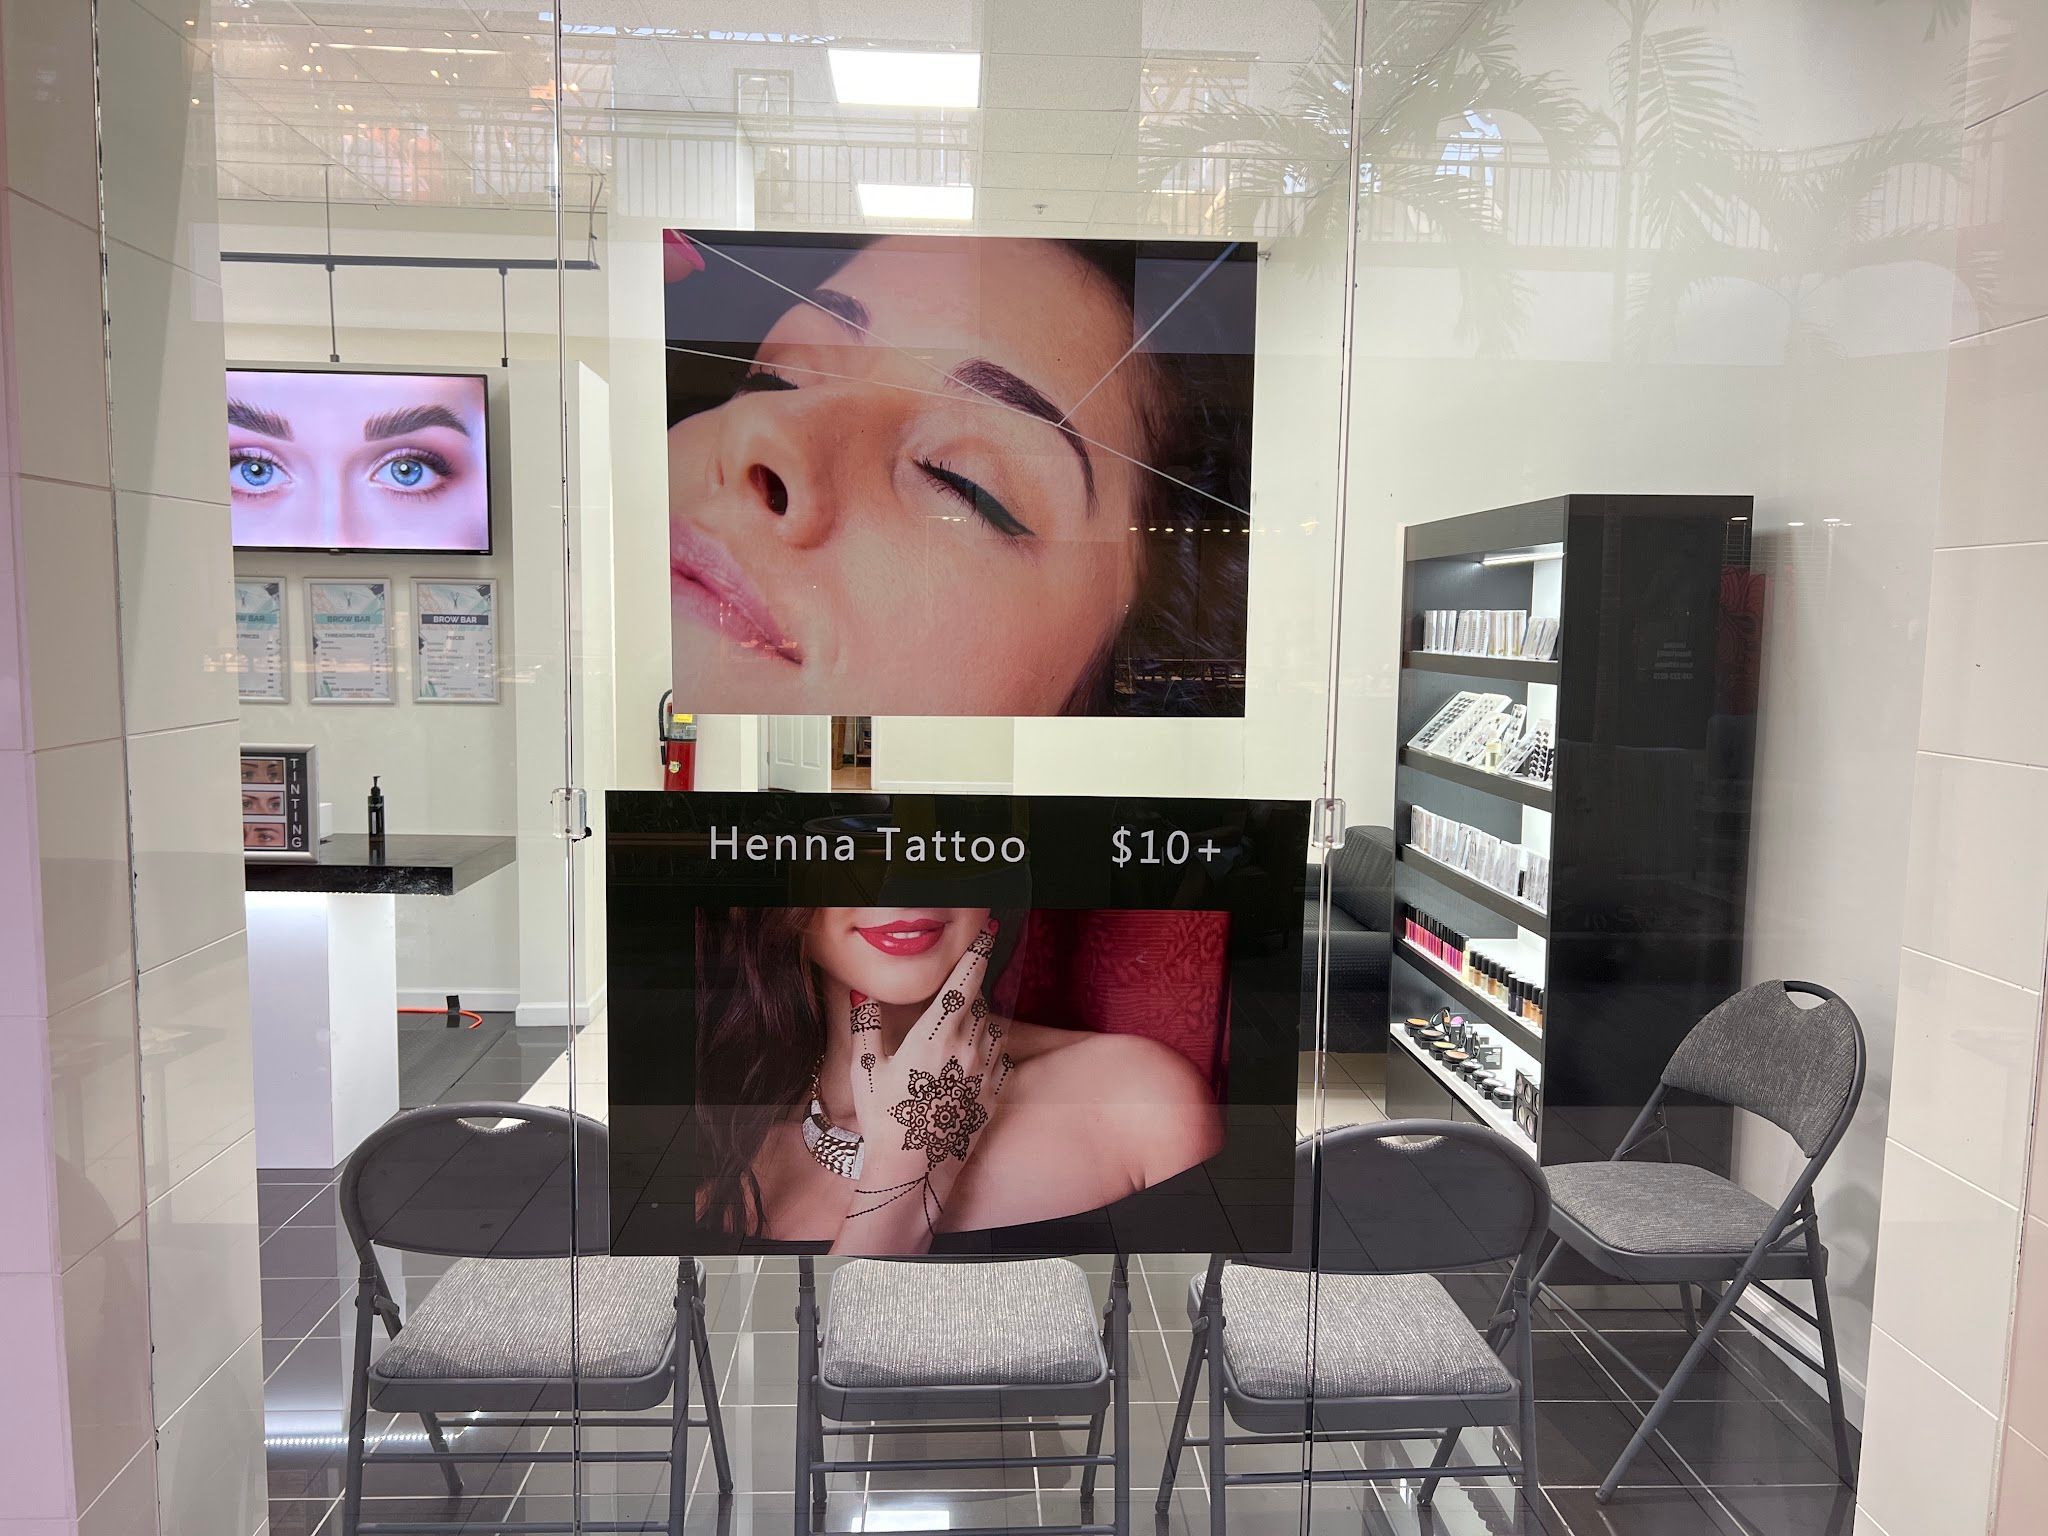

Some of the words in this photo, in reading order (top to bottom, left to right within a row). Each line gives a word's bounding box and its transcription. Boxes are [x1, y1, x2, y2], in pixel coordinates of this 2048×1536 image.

[248, 614, 265, 622] BAR
[327, 615, 352, 623] BROW
[354, 615, 371, 623] BAR
[433, 615, 459, 623] BROW
[460, 616, 477, 624] BAR
[290, 758, 302, 848] TINTING
[710, 825, 855, 862] Henna
[876, 827, 1025, 864] Tattoo
[1112, 825, 1221, 868] $10+
